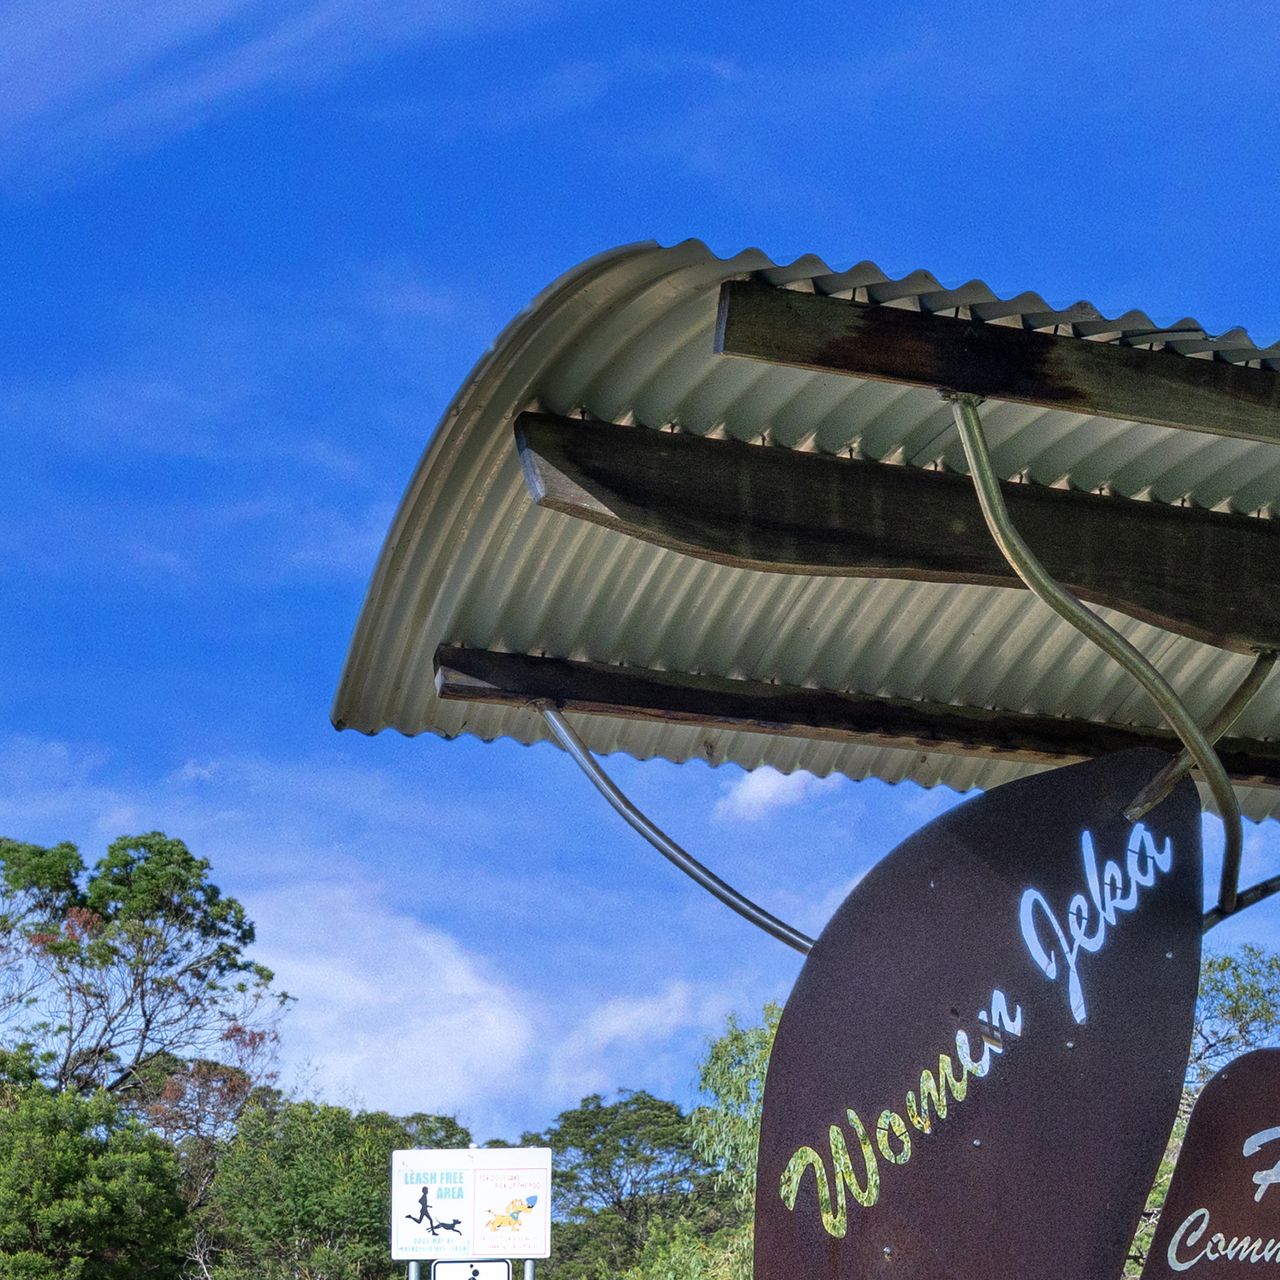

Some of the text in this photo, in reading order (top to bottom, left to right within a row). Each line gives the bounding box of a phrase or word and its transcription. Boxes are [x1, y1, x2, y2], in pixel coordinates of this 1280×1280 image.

[1020, 823, 1173, 1025] Jeka
[404, 1172, 464, 1185] LEASH FREE
[436, 1187, 464, 1199] AREA
